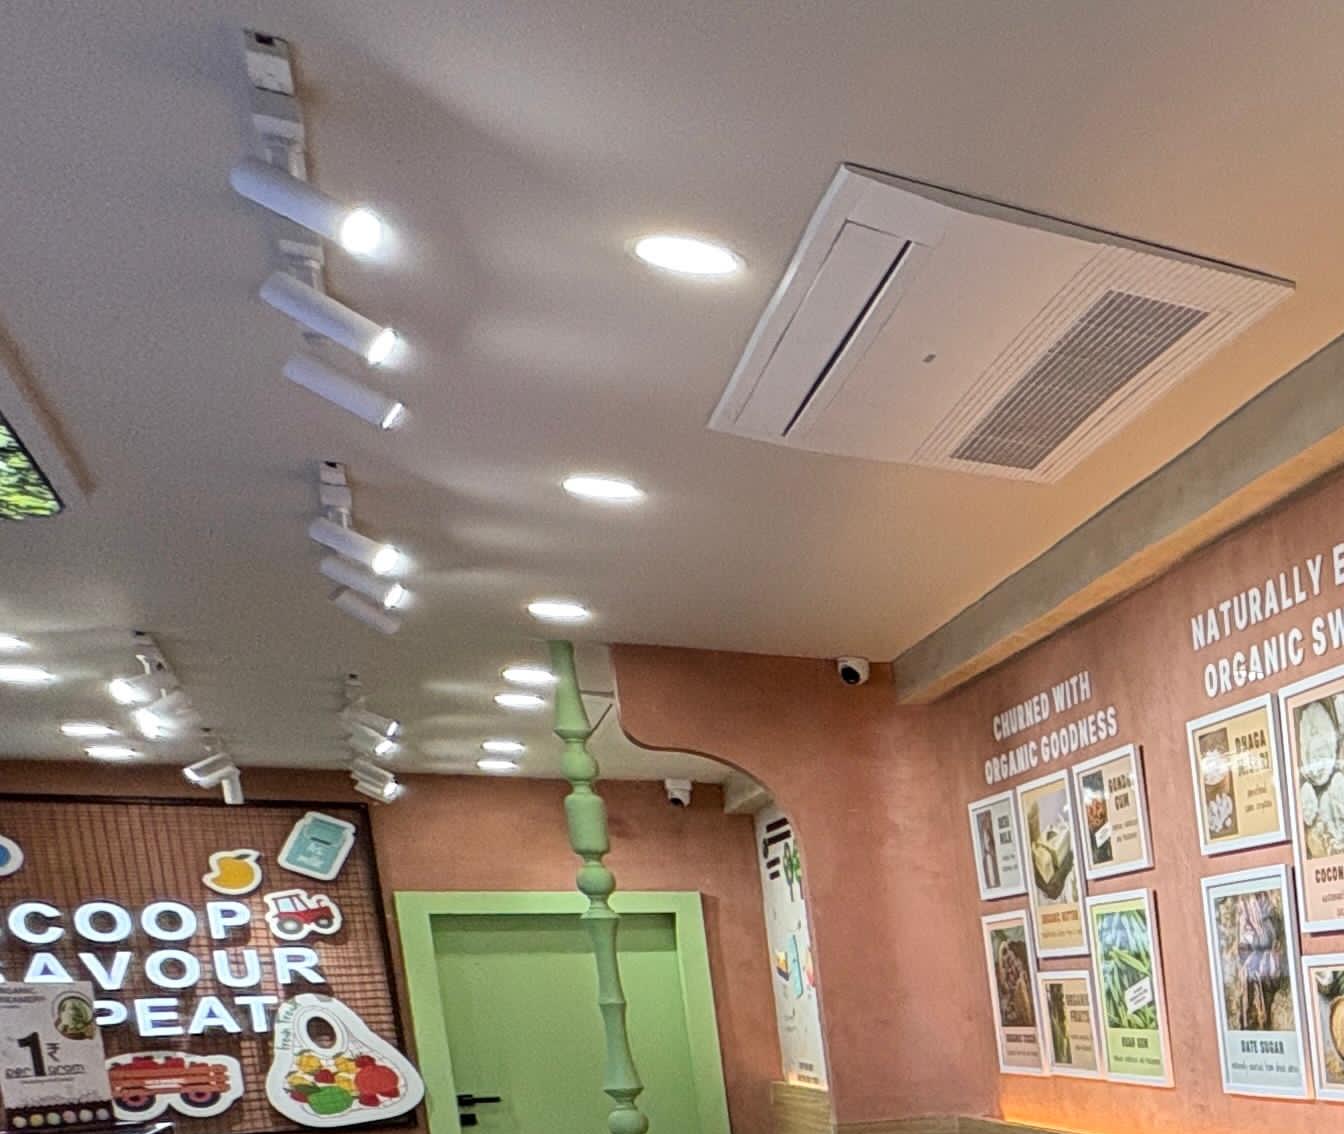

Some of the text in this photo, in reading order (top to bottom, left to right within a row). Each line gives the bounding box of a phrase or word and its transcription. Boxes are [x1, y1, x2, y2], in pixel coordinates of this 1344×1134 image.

[1191, 555, 1322, 650] NATURALLY
[1204, 628, 1304, 698] ORGANIC
[992, 671, 1091, 742] CHURNED WITH
[984, 706, 1117, 784] ORGANIC GOODNESS
[0, 901, 251, 943] COOP
[0, 947, 325, 990] AVOUR
